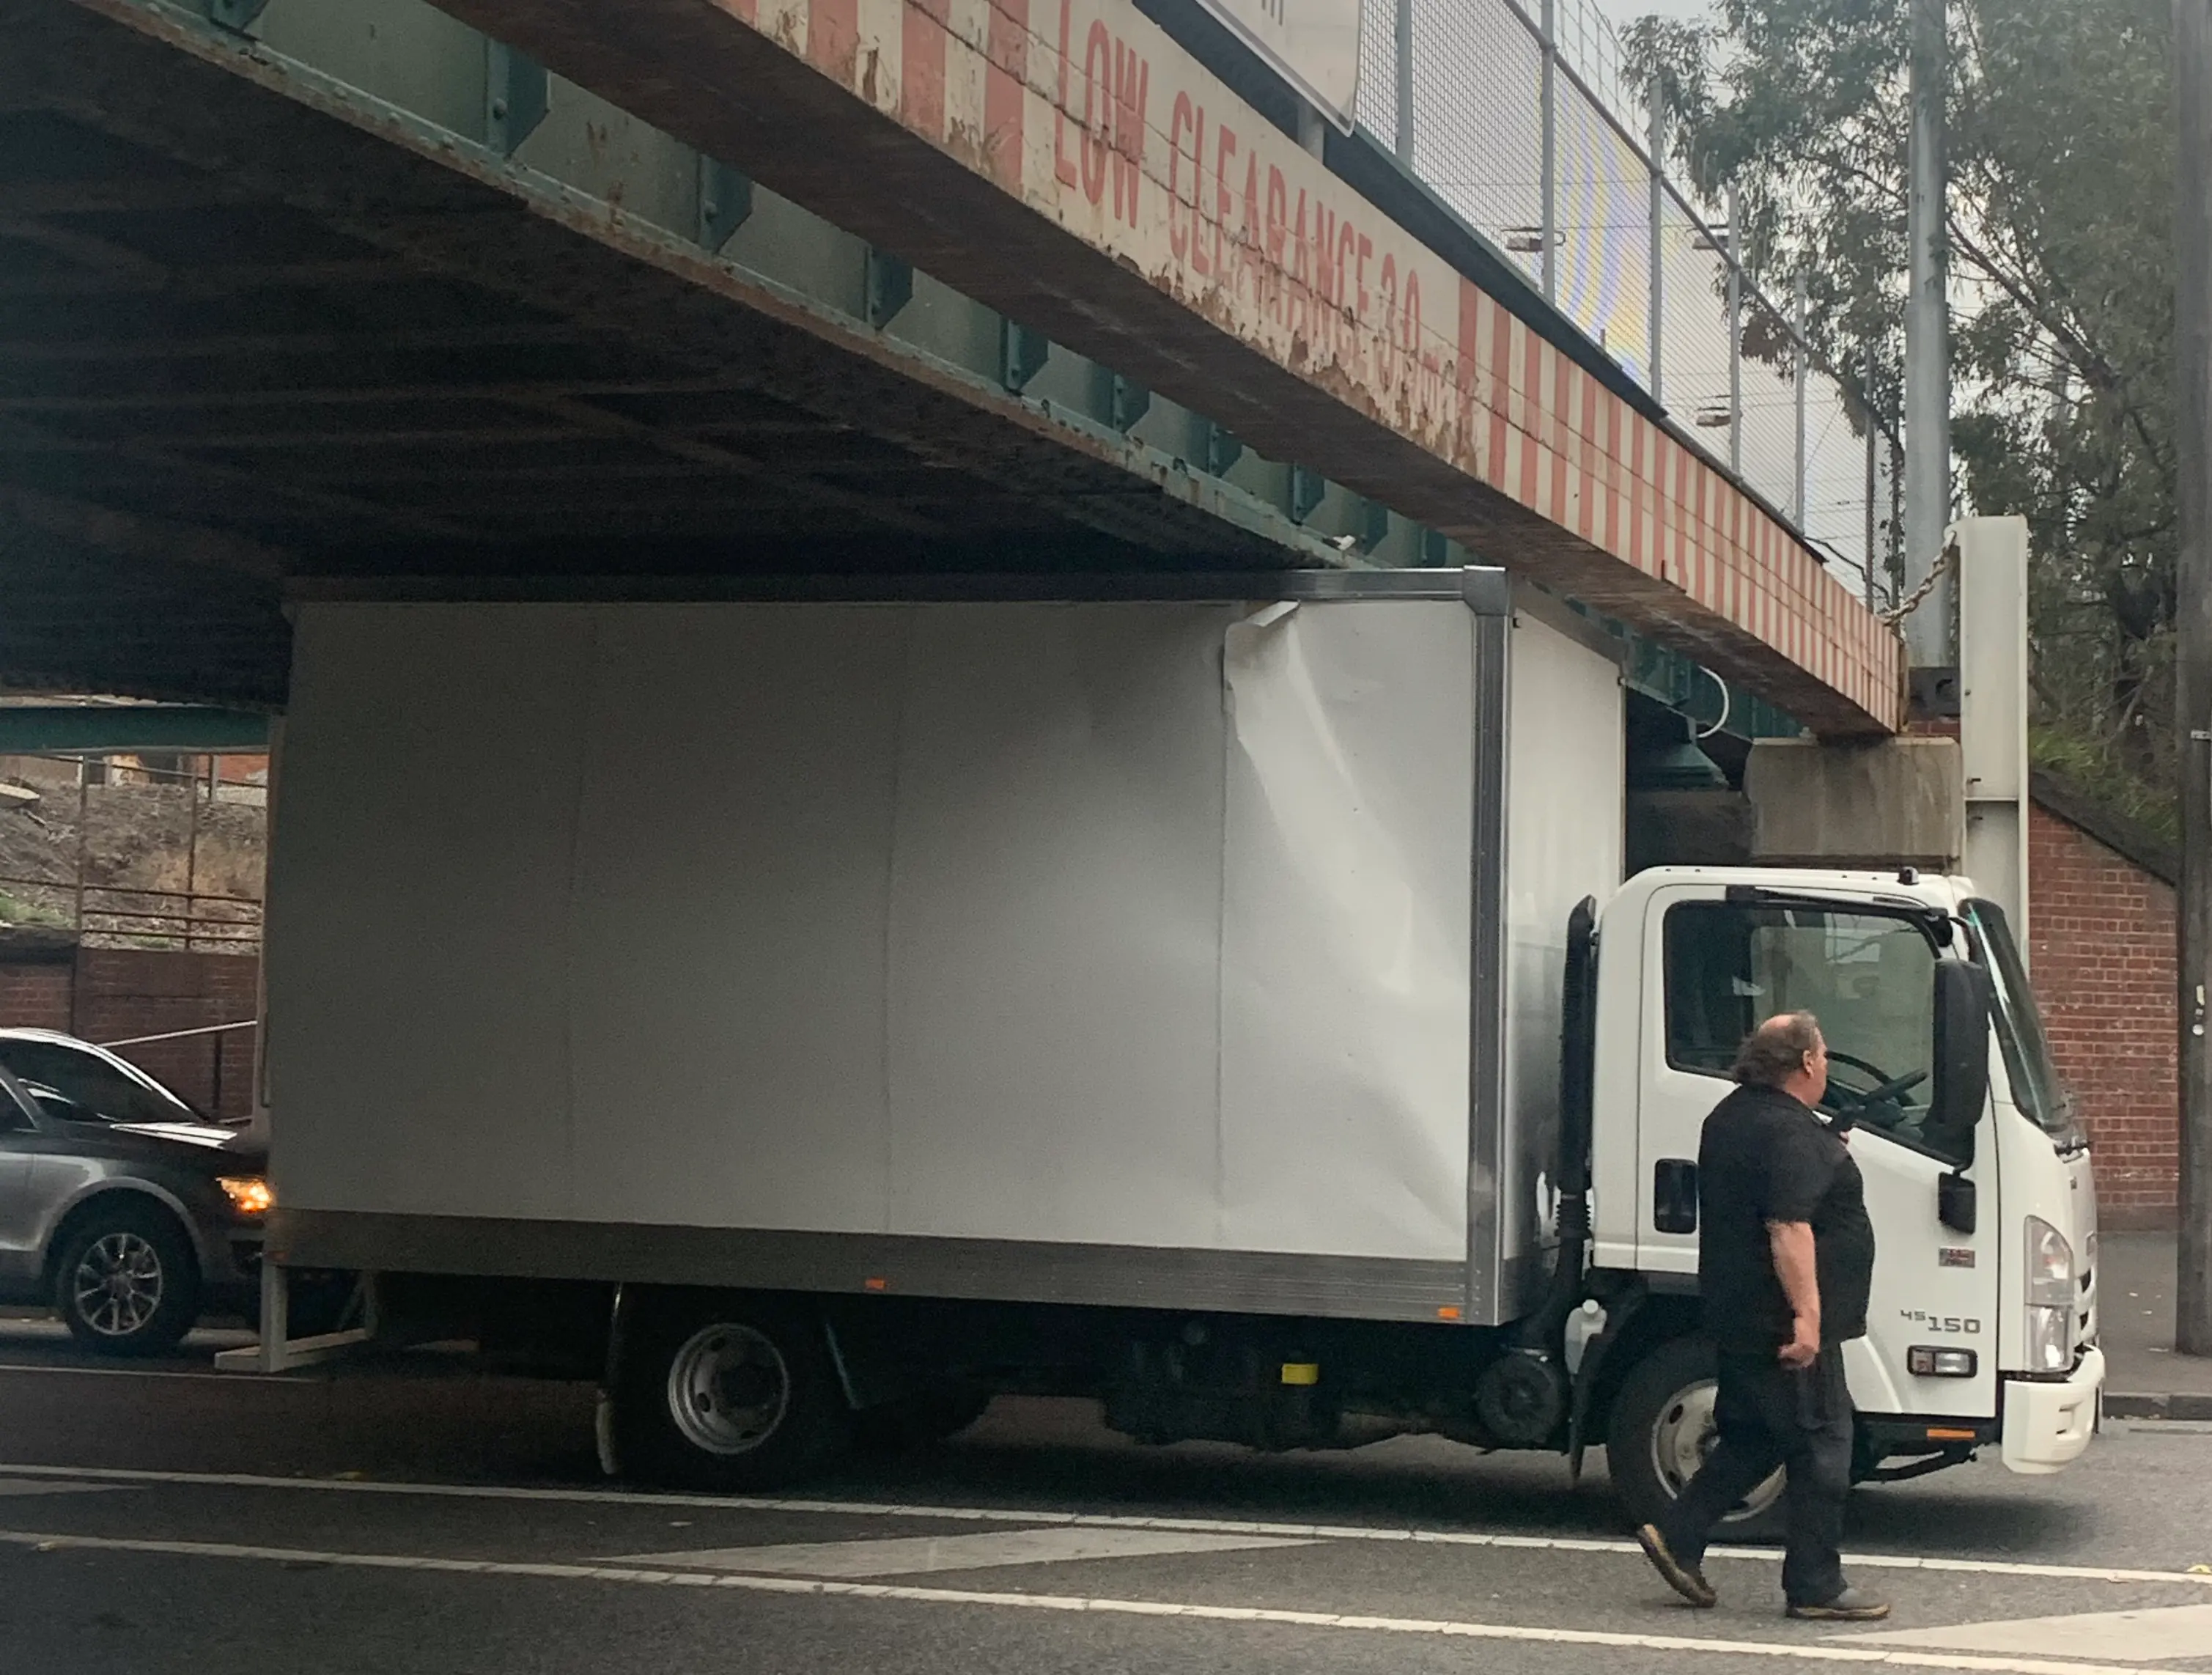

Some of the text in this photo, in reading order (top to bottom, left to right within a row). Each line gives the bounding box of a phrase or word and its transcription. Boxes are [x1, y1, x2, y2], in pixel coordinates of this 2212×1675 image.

[1053, 0, 1149, 229] LOW
[1168, 90, 1373, 385] CLEARANCE
[1928, 1316, 1980, 1333] 150
